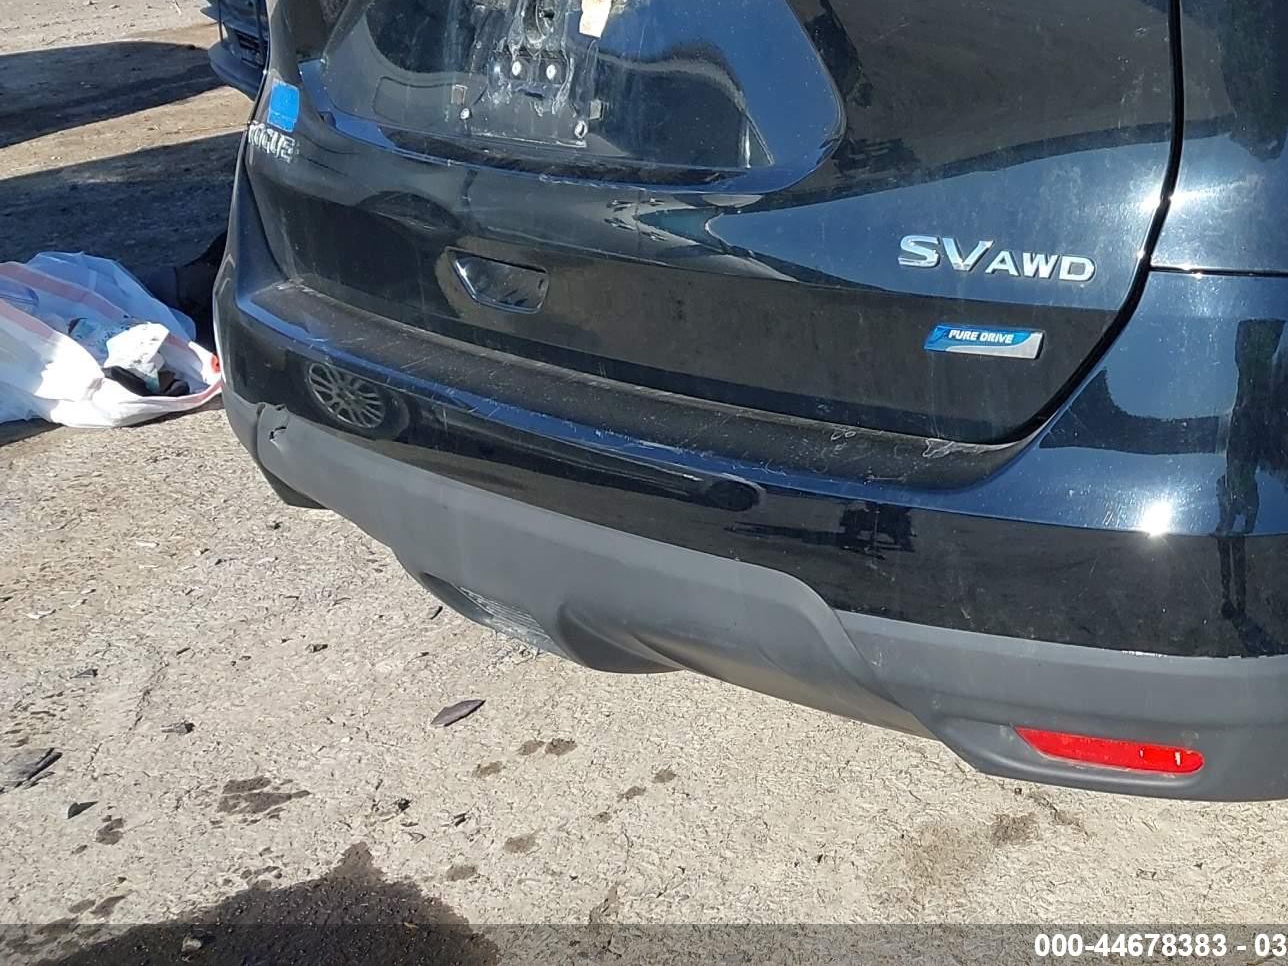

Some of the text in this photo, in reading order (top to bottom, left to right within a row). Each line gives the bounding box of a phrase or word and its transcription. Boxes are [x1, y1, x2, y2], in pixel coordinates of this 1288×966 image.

[898, 234, 1097, 282] SV AWD
[948, 329, 1015, 344] PURE DRIVE
